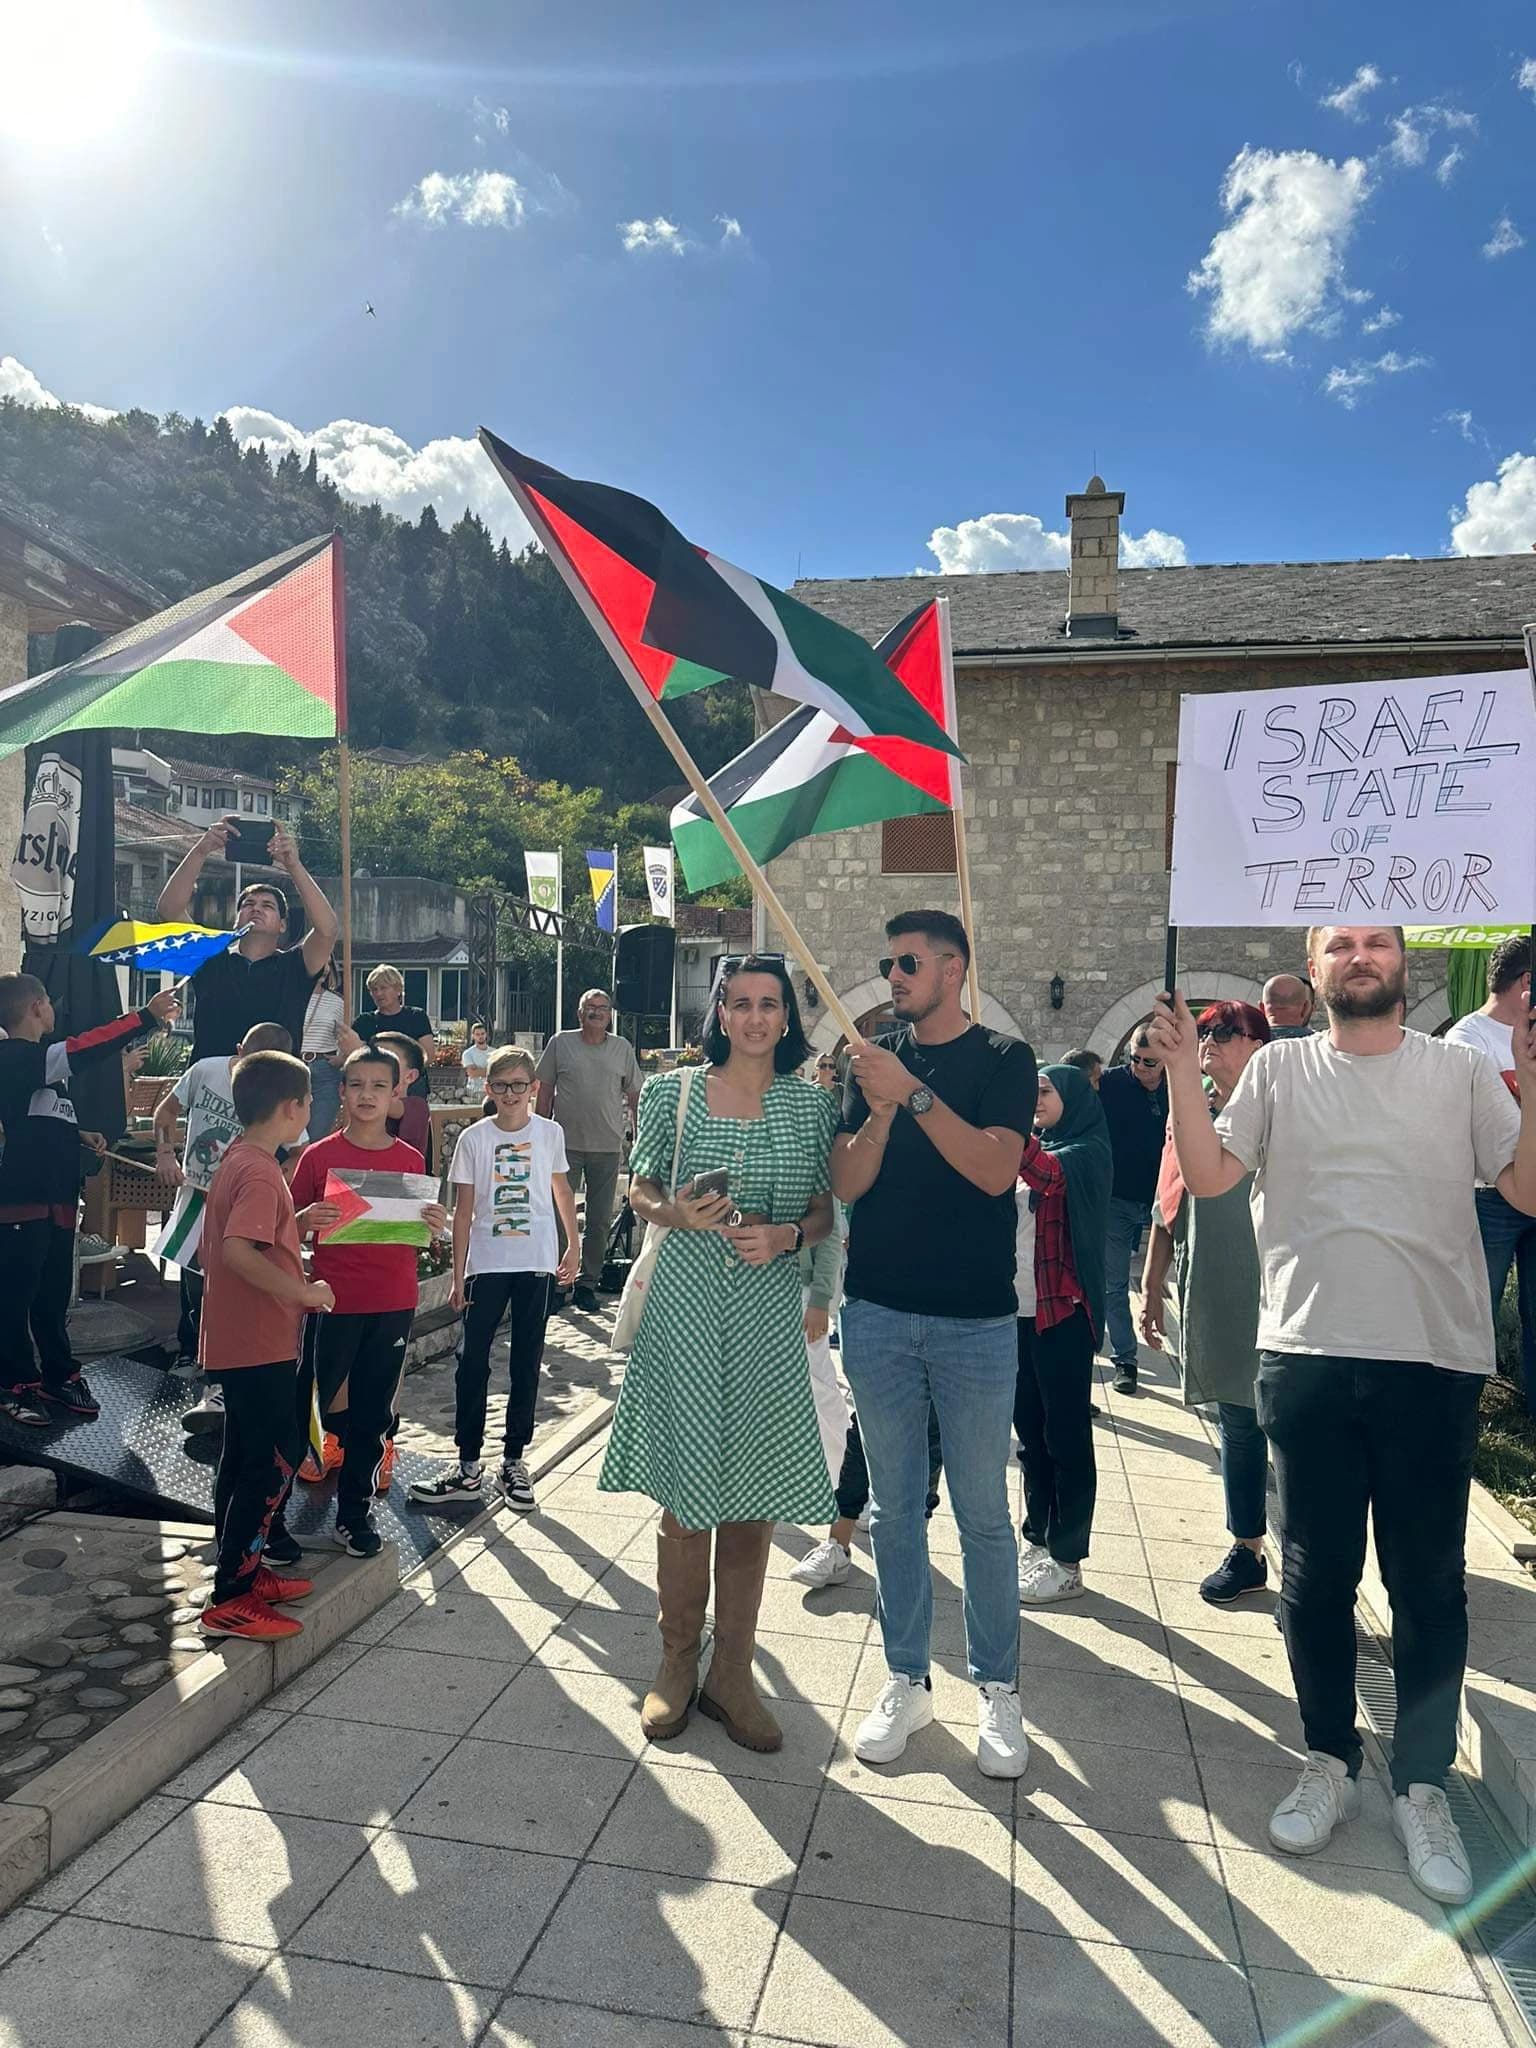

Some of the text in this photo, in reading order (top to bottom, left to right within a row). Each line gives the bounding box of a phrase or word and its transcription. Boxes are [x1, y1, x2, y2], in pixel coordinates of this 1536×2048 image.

[1224, 689, 1520, 772] ISRAEL
[1252, 758, 1492, 833] STATE
[1331, 825, 1391, 855] OF
[1244, 854, 1499, 913] TERROR
[492, 1142, 532, 1237] RIDER
